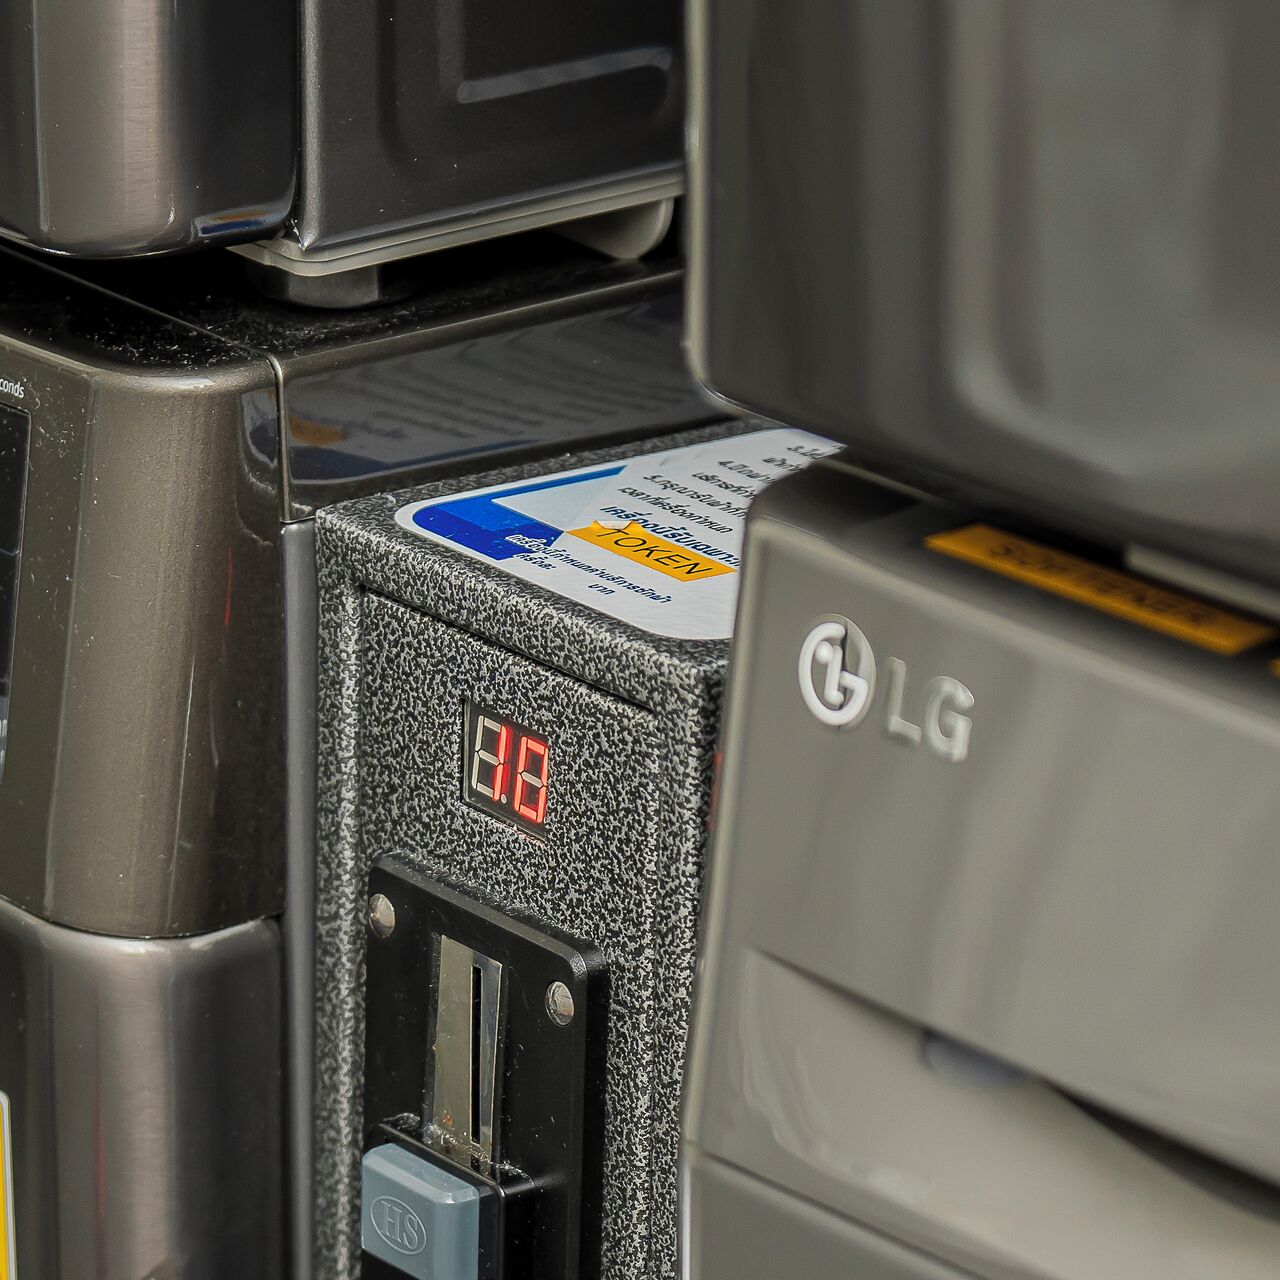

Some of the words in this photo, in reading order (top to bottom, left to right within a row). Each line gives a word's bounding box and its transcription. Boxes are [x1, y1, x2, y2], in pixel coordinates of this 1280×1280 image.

[596, 528, 714, 576] TOKEN
[886, 656, 975, 762] LG
[380, 1200, 418, 1250] HS
